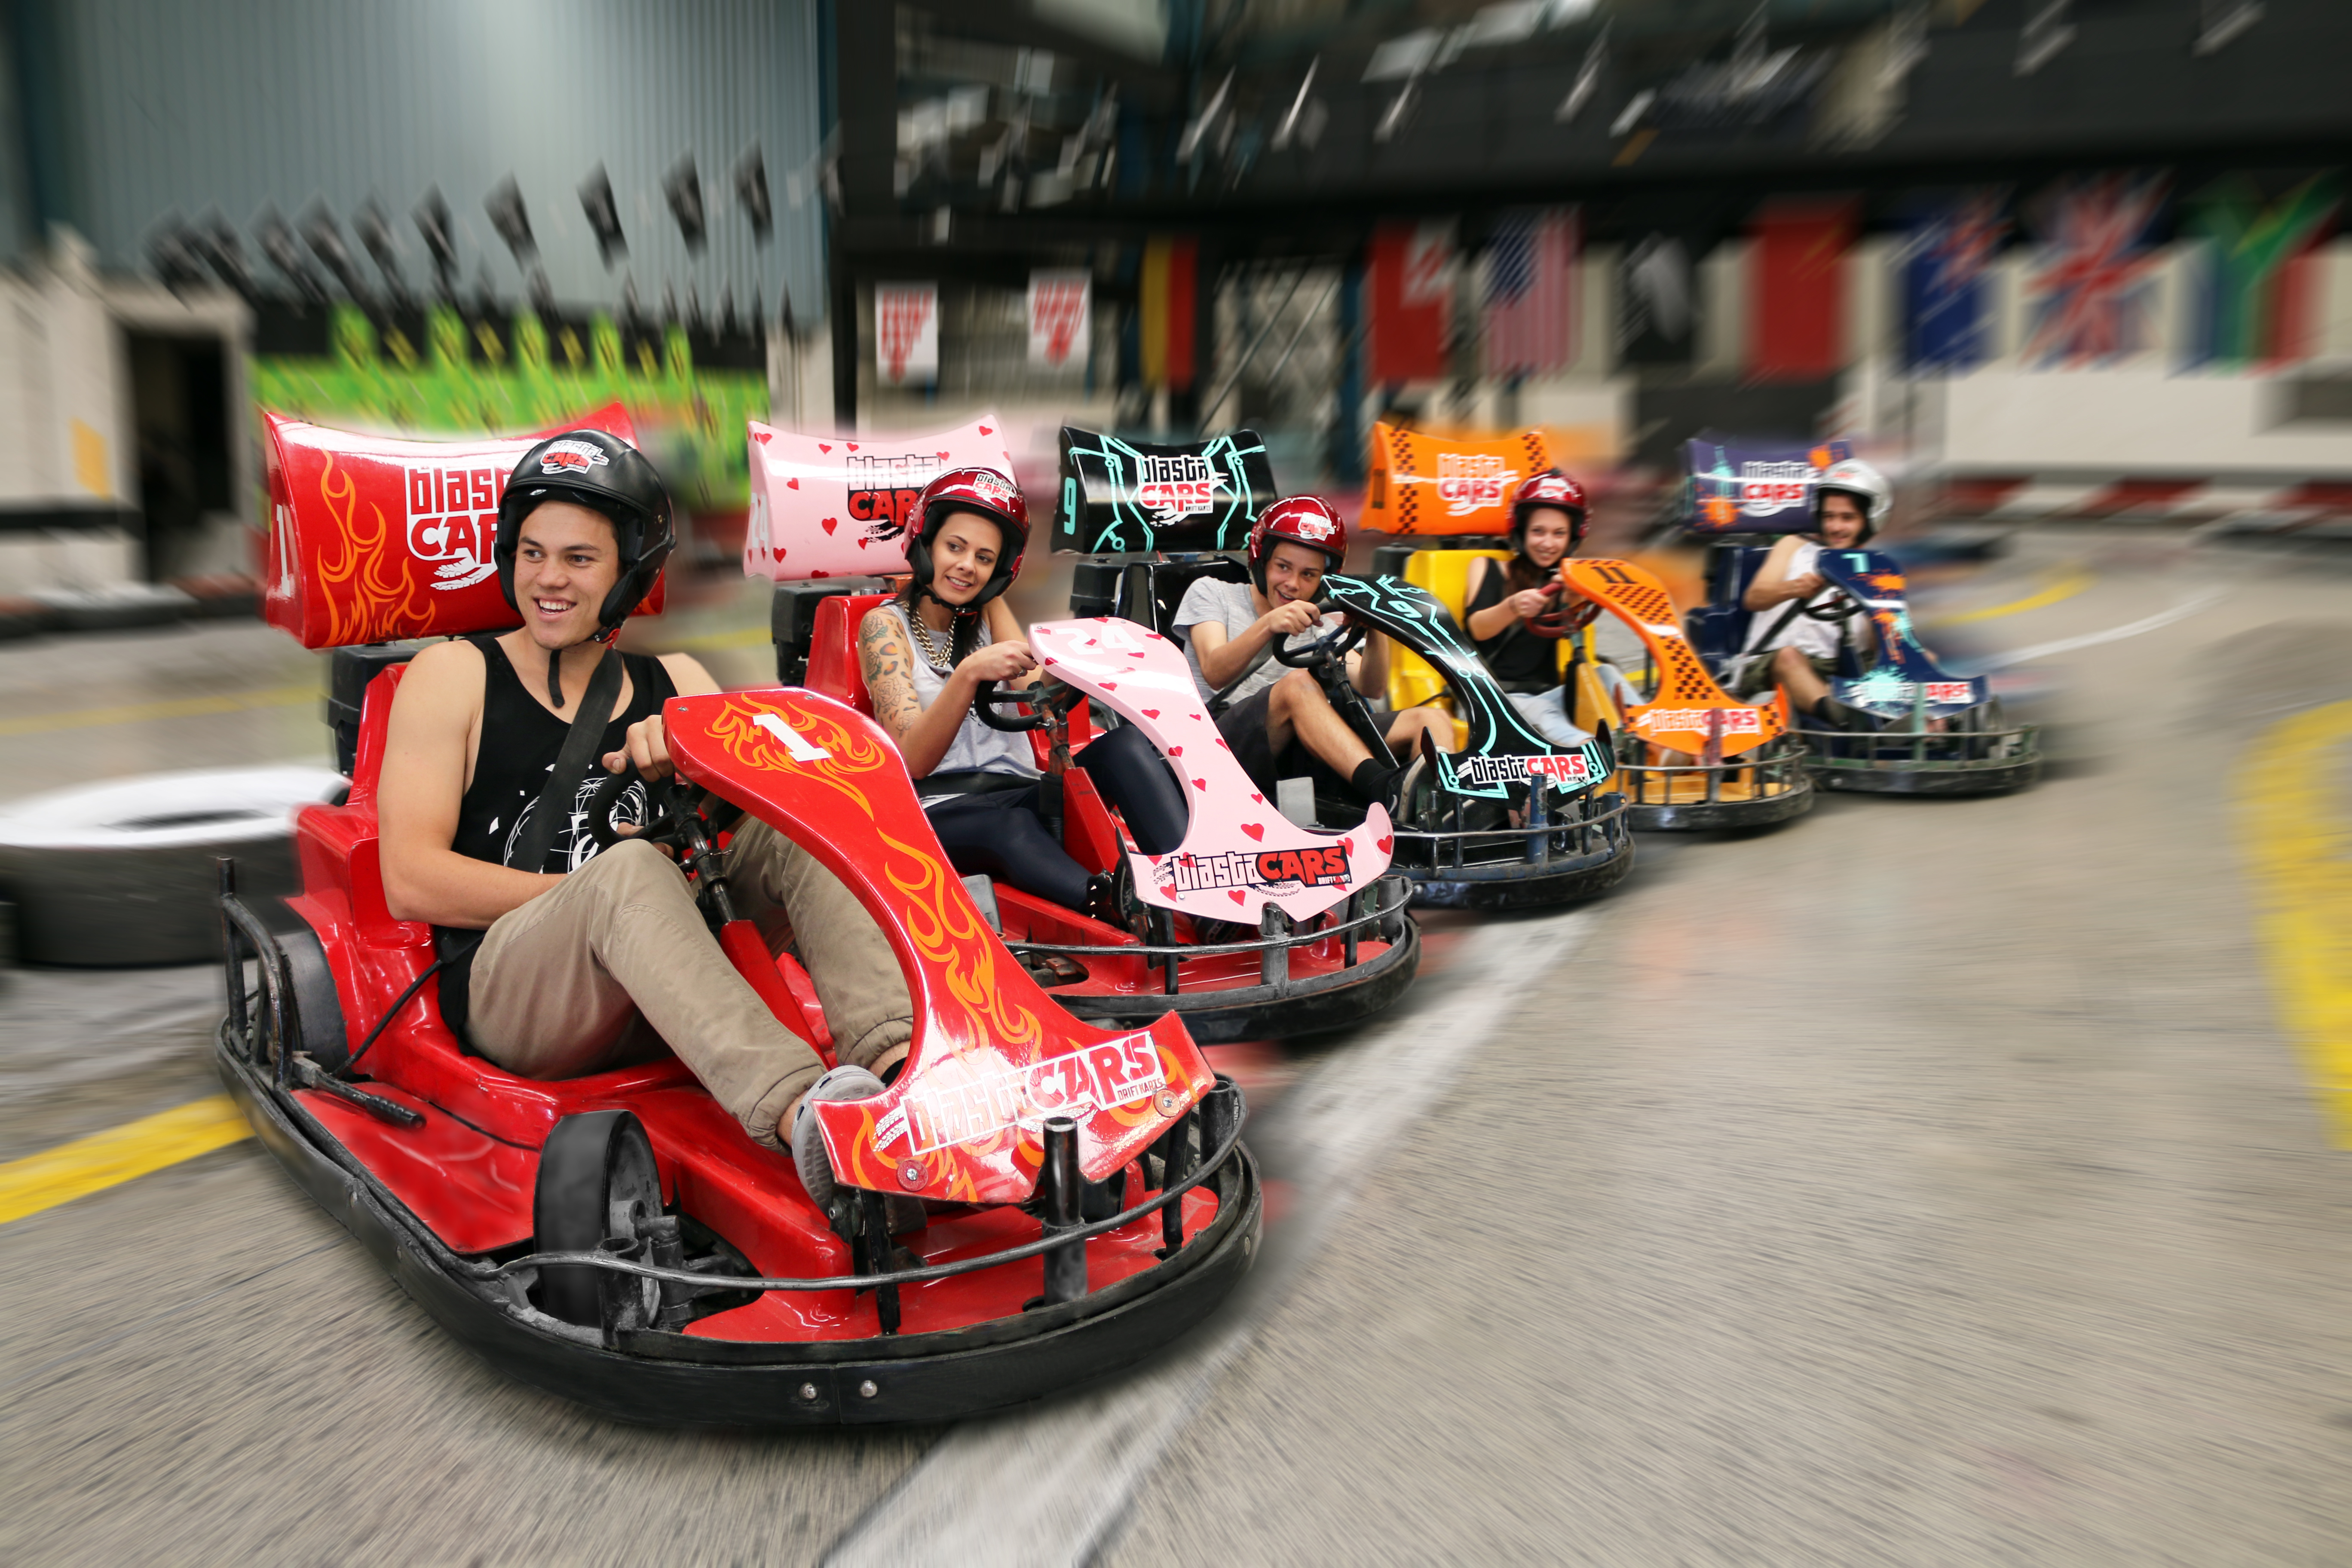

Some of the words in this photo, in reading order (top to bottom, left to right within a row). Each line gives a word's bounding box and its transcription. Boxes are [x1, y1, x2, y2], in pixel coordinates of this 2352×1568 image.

[542, 452, 589, 467] CARS
[975, 482, 1009, 498] CARS
[1141, 483, 1211, 512] CARS
[849, 490, 918, 526] CAR
[1064, 477, 1077, 535] 9
[751, 493, 769, 552] 24
[276, 504, 291, 597] 1
[411, 514, 499, 564] CAR
[1589, 566, 1639, 584] 11
[1841, 553, 1870, 573] 7
[1387, 600, 1423, 619] 9
[1054, 625, 1146, 655] 24
[753, 713, 833, 762] 1
[1527, 756, 1585, 781] CARS
[1258, 848, 1346, 885] CARS
[1030, 1033, 1156, 1109] CARS
[1117, 1085, 1139, 1101] DRIFT
[1138, 1078, 1164, 1094] KARTS
